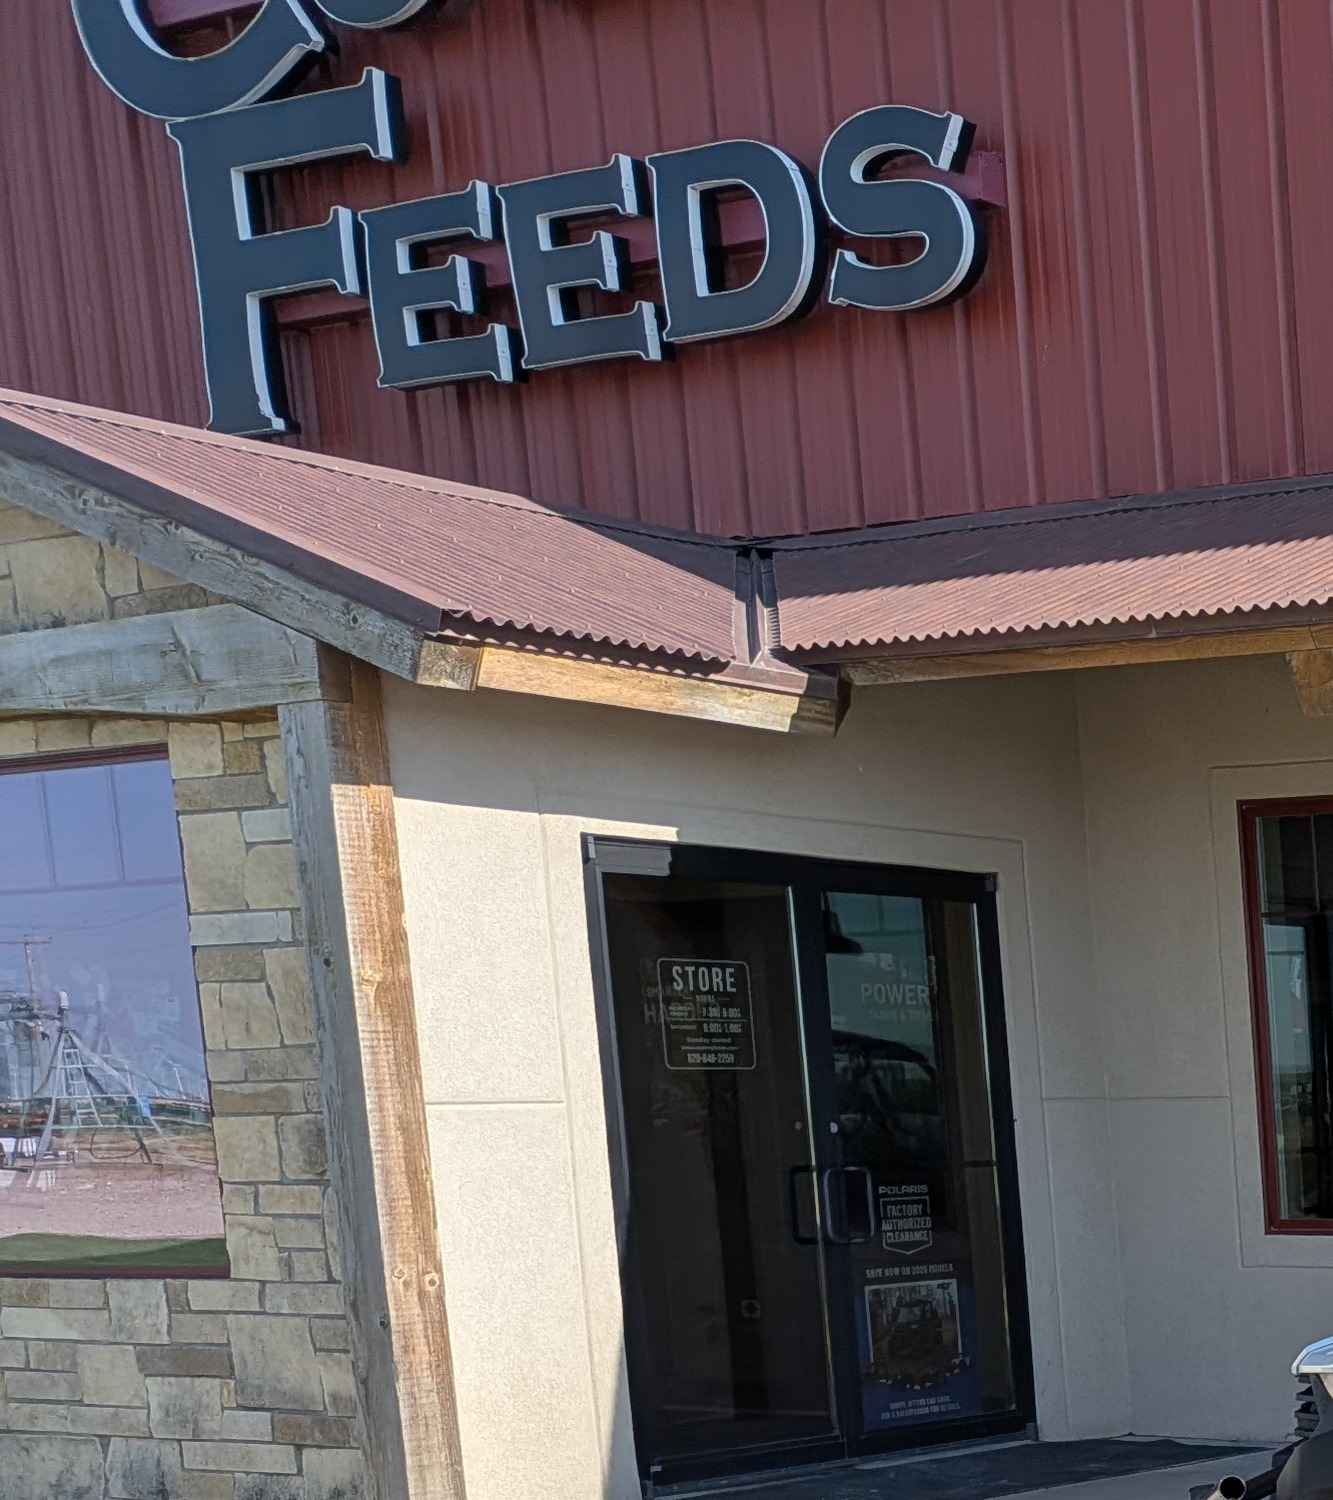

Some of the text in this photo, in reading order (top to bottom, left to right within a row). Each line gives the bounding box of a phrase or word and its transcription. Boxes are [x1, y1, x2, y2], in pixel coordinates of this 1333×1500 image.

[165, 66, 985, 434] FEEDS
[671, 965, 737, 993] STORE
[860, 982, 930, 1006] POWER
[878, 1184, 929, 1195] POLARIS
[887, 1204, 923, 1217] FACTORY
[881, 1217, 932, 1230] AUTHORIZED
[886, 1231, 929, 1243] CLEARANCE
[865, 1268, 883, 1279] SAVE
[884, 1267, 900, 1277] NOW
[928, 1263, 954, 1274] MODELS
